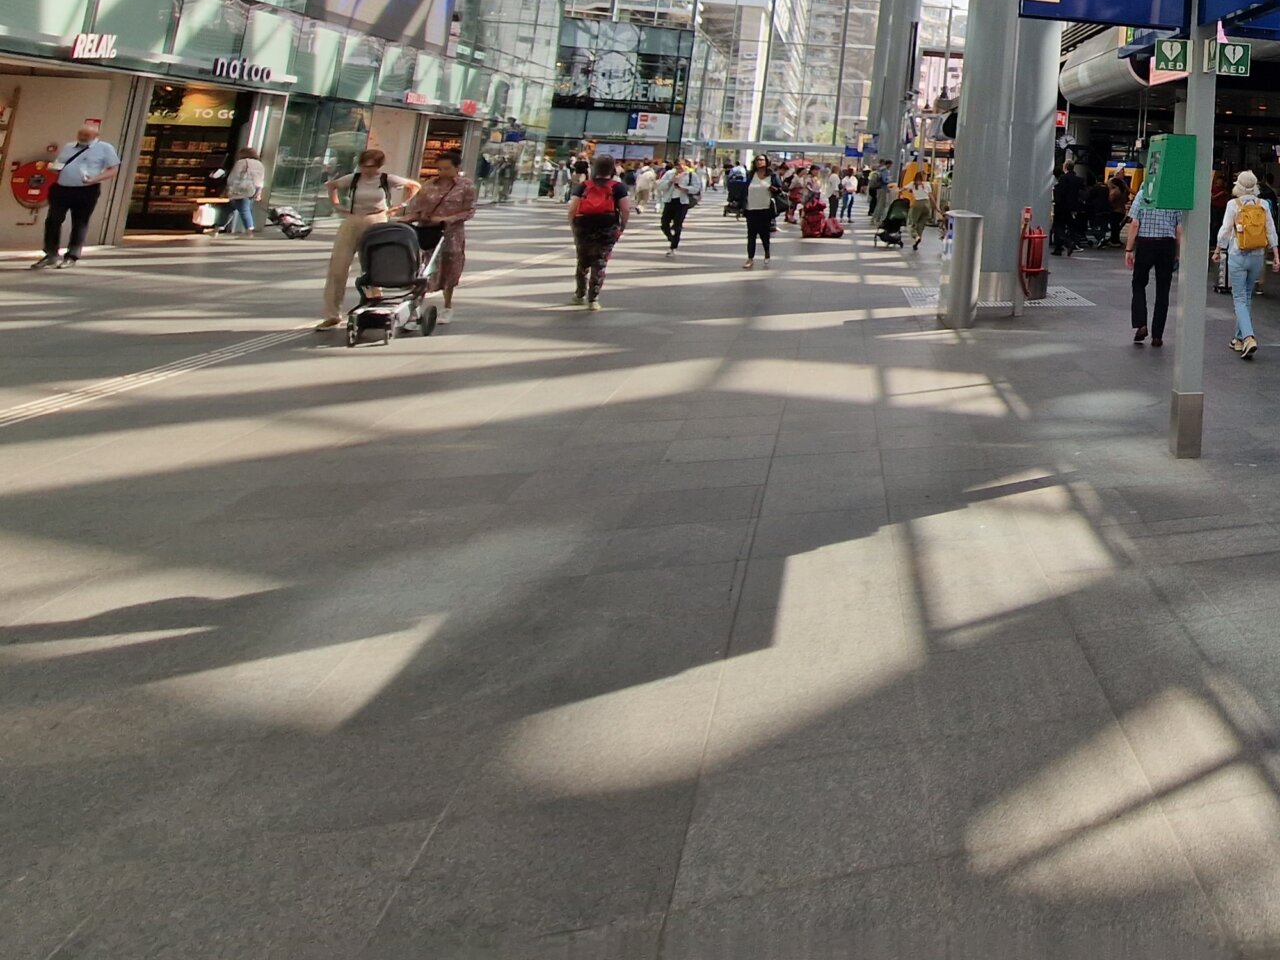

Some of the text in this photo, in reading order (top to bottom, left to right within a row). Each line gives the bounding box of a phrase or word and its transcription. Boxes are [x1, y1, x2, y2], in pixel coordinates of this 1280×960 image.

[213, 56, 272, 84] natoo
[1158, 61, 1184, 70] AED
[1221, 65, 1246, 74] AED
[194, 108, 214, 119] TO
